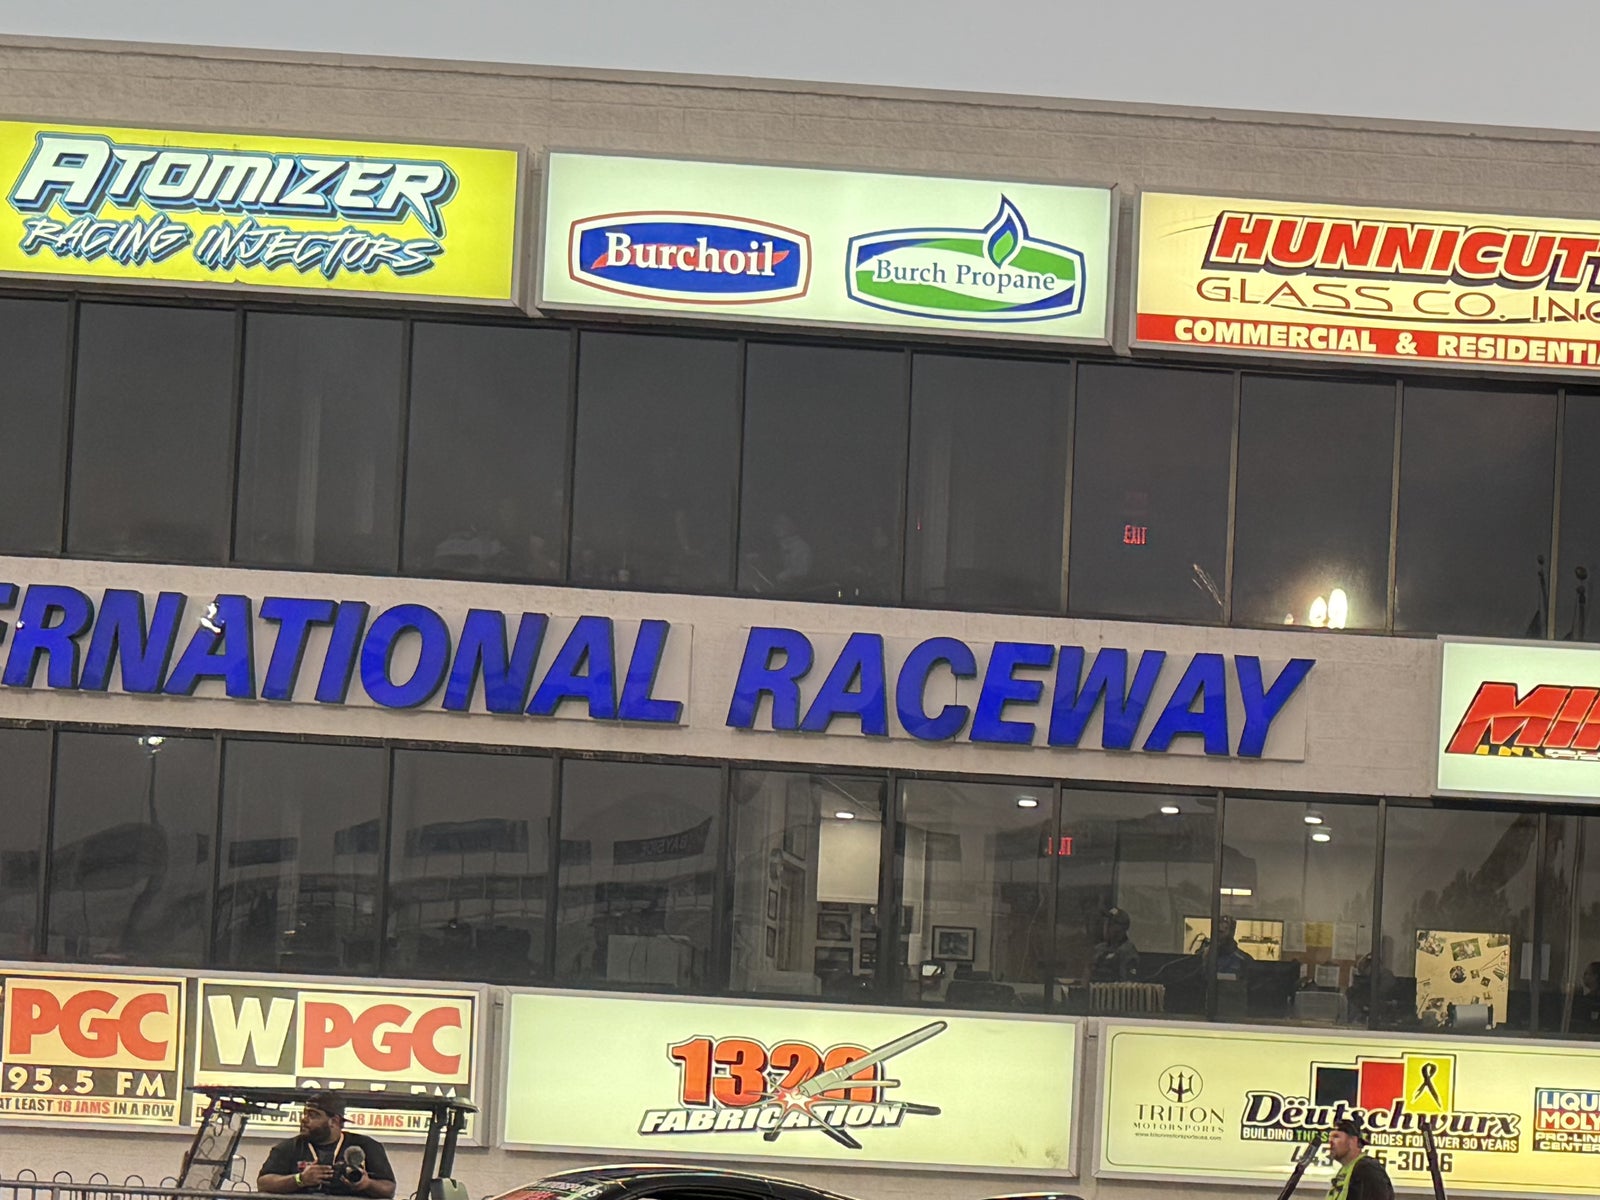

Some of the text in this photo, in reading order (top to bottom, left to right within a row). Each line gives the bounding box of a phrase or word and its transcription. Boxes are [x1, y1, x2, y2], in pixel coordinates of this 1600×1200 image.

[10, 132, 458, 236] ATOMIZER
[20, 214, 443, 279] RACING INJECTORS
[605, 232, 776, 277] Burchoil
[874, 258, 1056, 293] Burch Propane
[1196, 276, 1394, 312] GLASS
[1413, 292, 1506, 321] CO.
[1174, 318, 1377, 354] COMMERCIAL
[1395, 332, 1418, 355] &
[1123, 525, 1147, 545] EXIT
[725, 626, 1317, 760] RACEWAY
[9, 987, 170, 1061] PGC
[8, 1066, 166, 1098] 95.5 FM
[668, 1036, 880, 1107] 1320
[15, 1098, 54, 1112] LEAST
[57, 1100, 71, 1112] 18
[75, 1101, 111, 1115] JAMS
[113, 1102, 126, 1115] IN
[130, 1103, 139, 1117] A
[143, 1104, 175, 1117] ROW
[368, 1114, 404, 1127] JAMS
[408, 1116, 420, 1129] IN
[640, 1102, 904, 1136] FABRICATION
[1136, 1104, 1225, 1124] TRITON
[1133, 1122, 1224, 1133] MOTORSPORTS
[1243, 1127, 1293, 1140] BUILDING
[1371, 1133, 1403, 1146] RIDES
[1463, 1138, 1478, 1149] 30
[1481, 1139, 1518, 1152] YEARS
